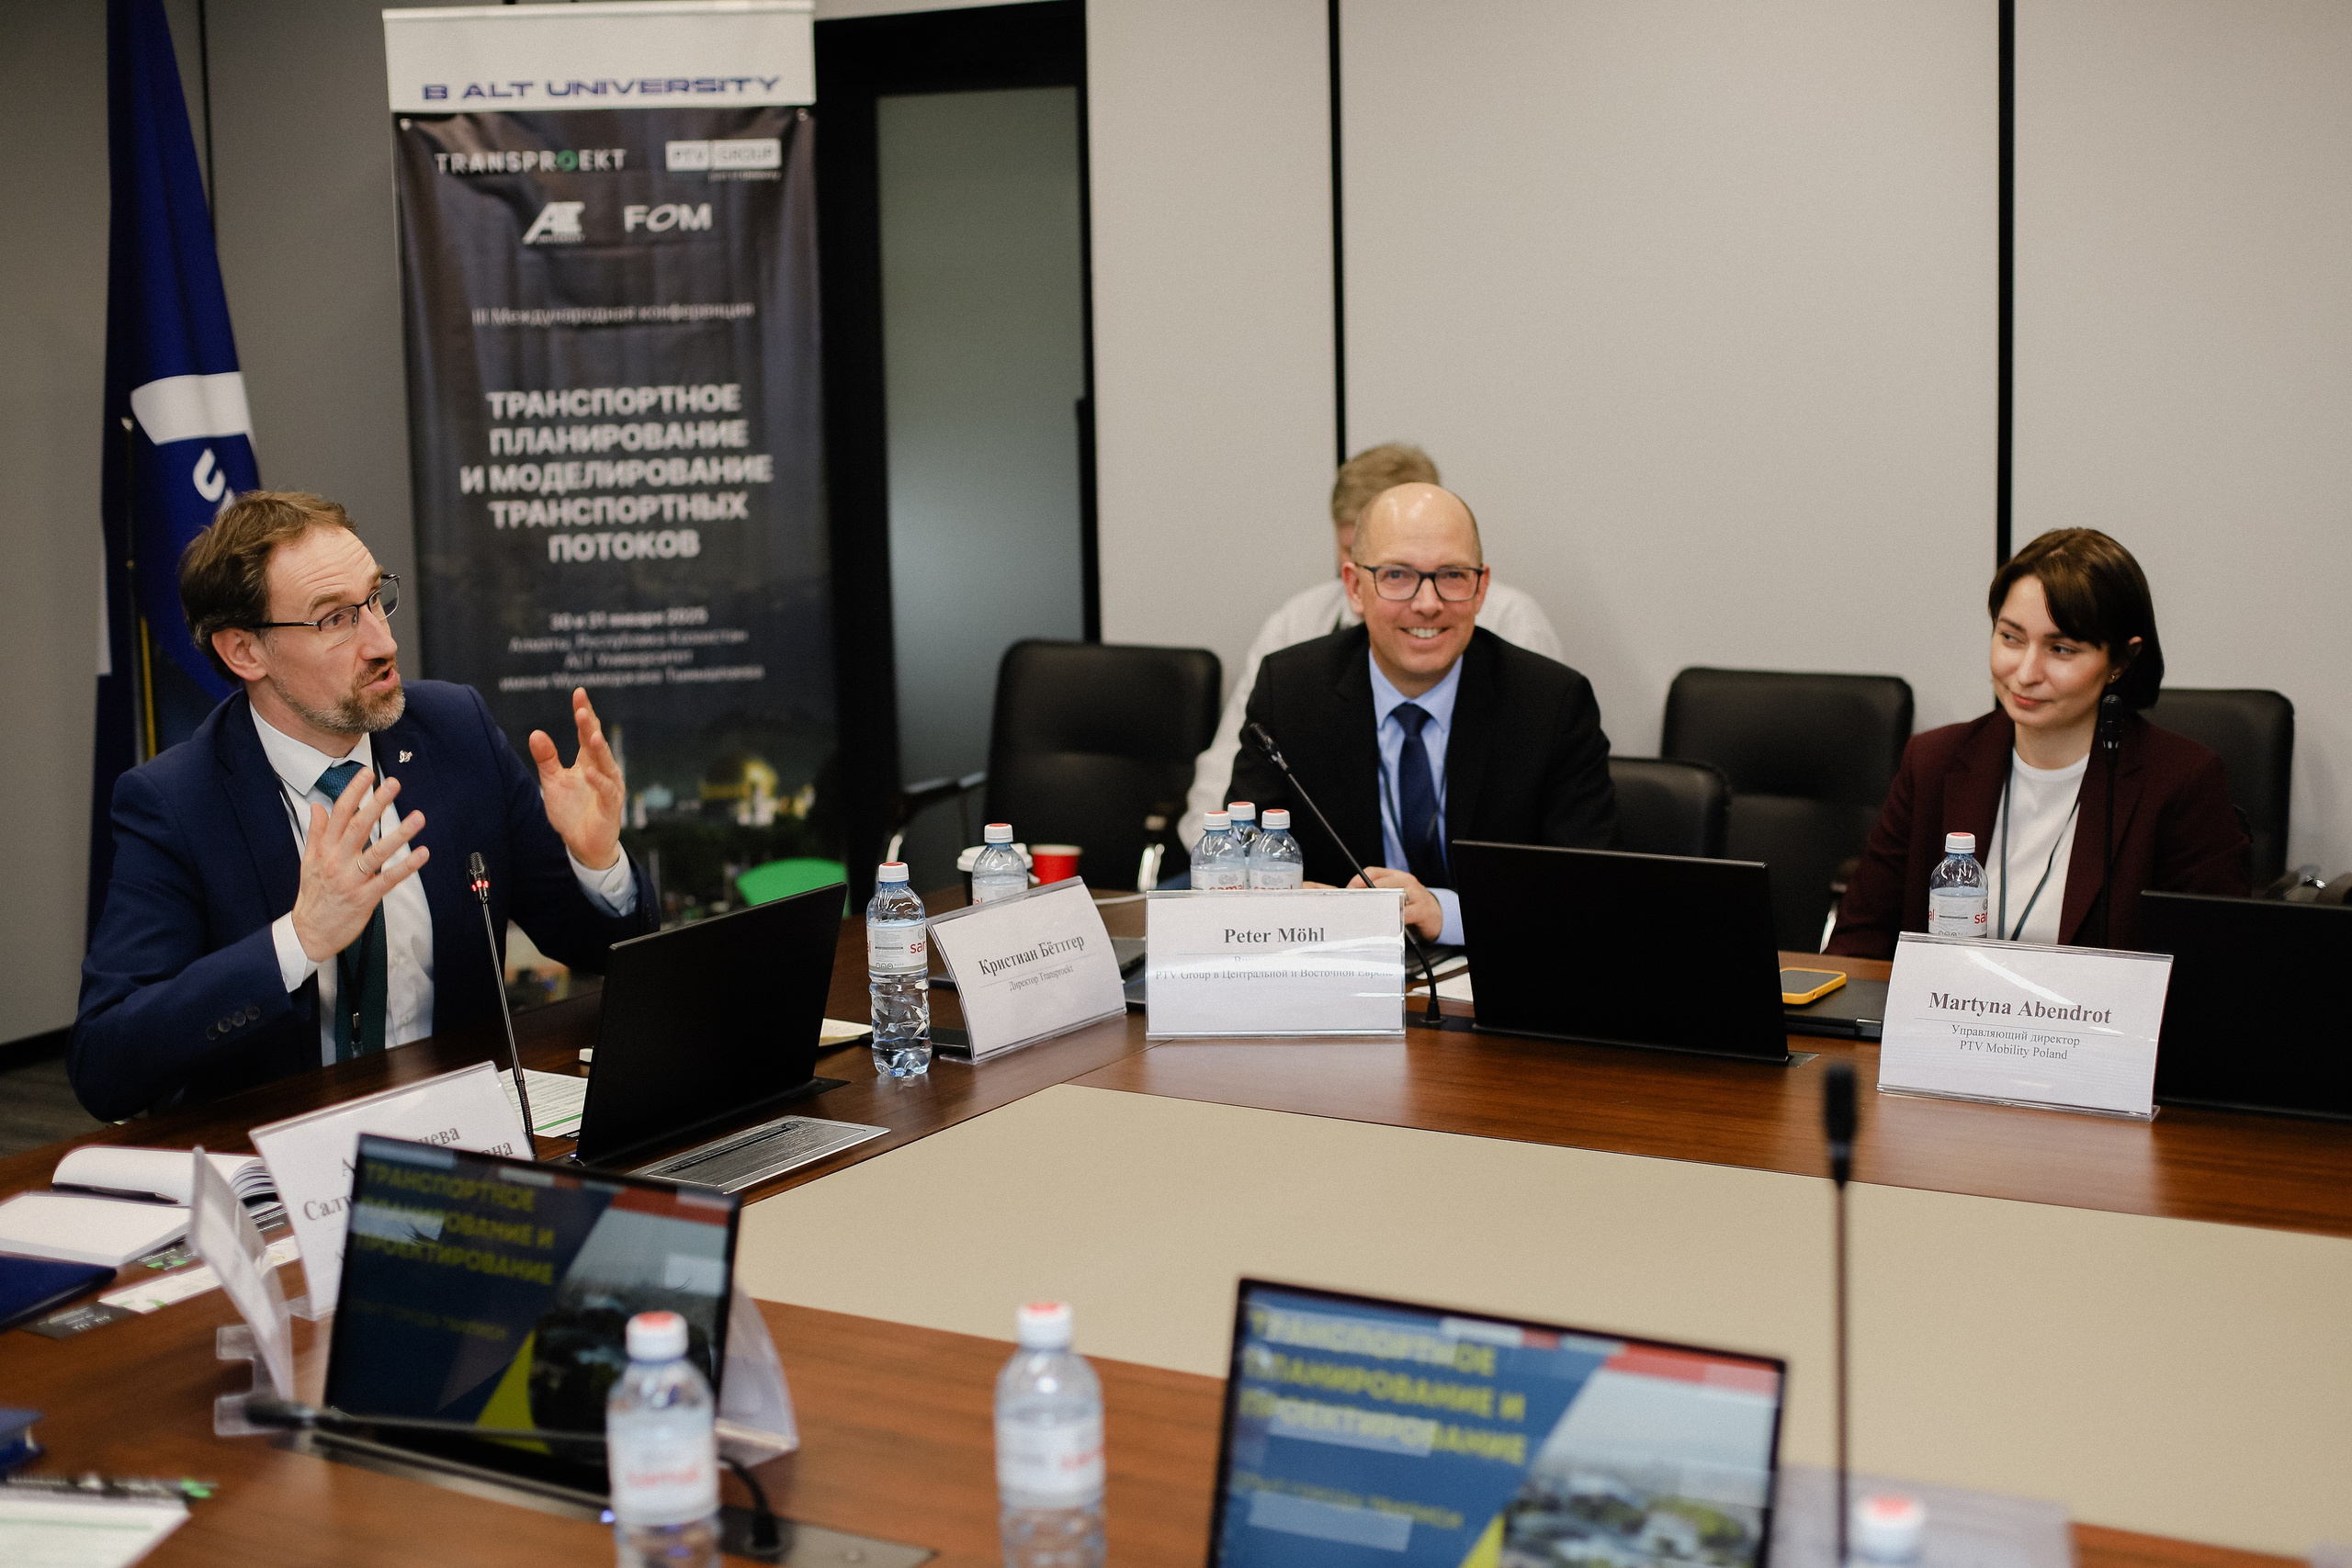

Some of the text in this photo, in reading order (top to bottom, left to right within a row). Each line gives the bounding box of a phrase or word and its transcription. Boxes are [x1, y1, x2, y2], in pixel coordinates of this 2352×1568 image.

[423, 76, 781, 99] B ALT UNIVERSITY
[435, 148, 628, 175] TRANSPROEKT
[624, 202, 713, 233] FOM
[492, 304, 636, 328] Международная
[639, 301, 755, 325] конференция
[486, 383, 741, 420] ТРАНСПОРТНОЕ
[489, 420, 749, 457] ПЛАНИРОВАНИЕ
[460, 455, 774, 496] И МОДЕЛИРОВАНИЕ
[488, 491, 749, 529] ТРАНСПОРТНЫХ
[548, 529, 701, 563] ПОТОКОВ
[1224, 926, 1326, 944] Peter Möhl
[978, 936, 1085, 976] Кристиан Бёттгер
[1008, 964, 1074, 992] Директор Transproekt
[1155, 970, 1177, 979] PTV
[1181, 971, 1211, 982] Group
[1222, 969, 1288, 980] Центральной
[1300, 969, 1354, 978] Восточной
[1928, 992, 2112, 1025] Martyna Abendrot
[1951, 1024, 2081, 1048] Управляющий директор
[1959, 1040, 2068, 1060] PTV Mobility Poland
[1498, 1391, 1526, 1422] И
